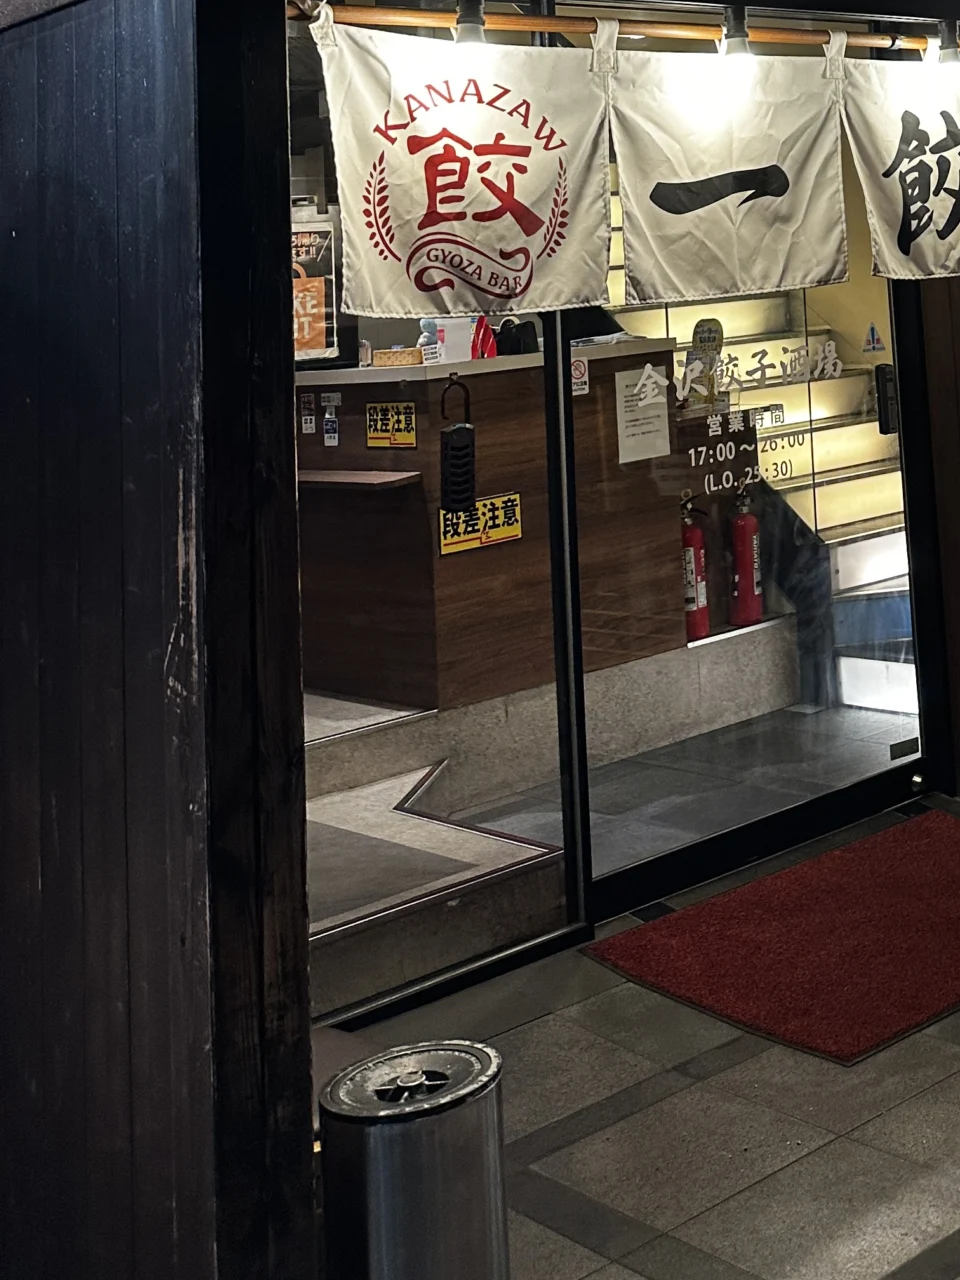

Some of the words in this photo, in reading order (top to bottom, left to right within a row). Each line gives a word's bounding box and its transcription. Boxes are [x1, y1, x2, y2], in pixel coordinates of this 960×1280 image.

[373, 78, 568, 152] KANAZAW
[407, 126, 545, 237] 餃
[649, 164, 790, 215] 一
[426, 247, 482, 281] GYOZA
[487, 271, 523, 293] BAR
[634, 340, 843, 408] 金沢餃子酒場
[367, 405, 416, 433] 段差注意
[706, 403, 786, 438] 営業時間
[441, 497, 521, 541] 段差注意
